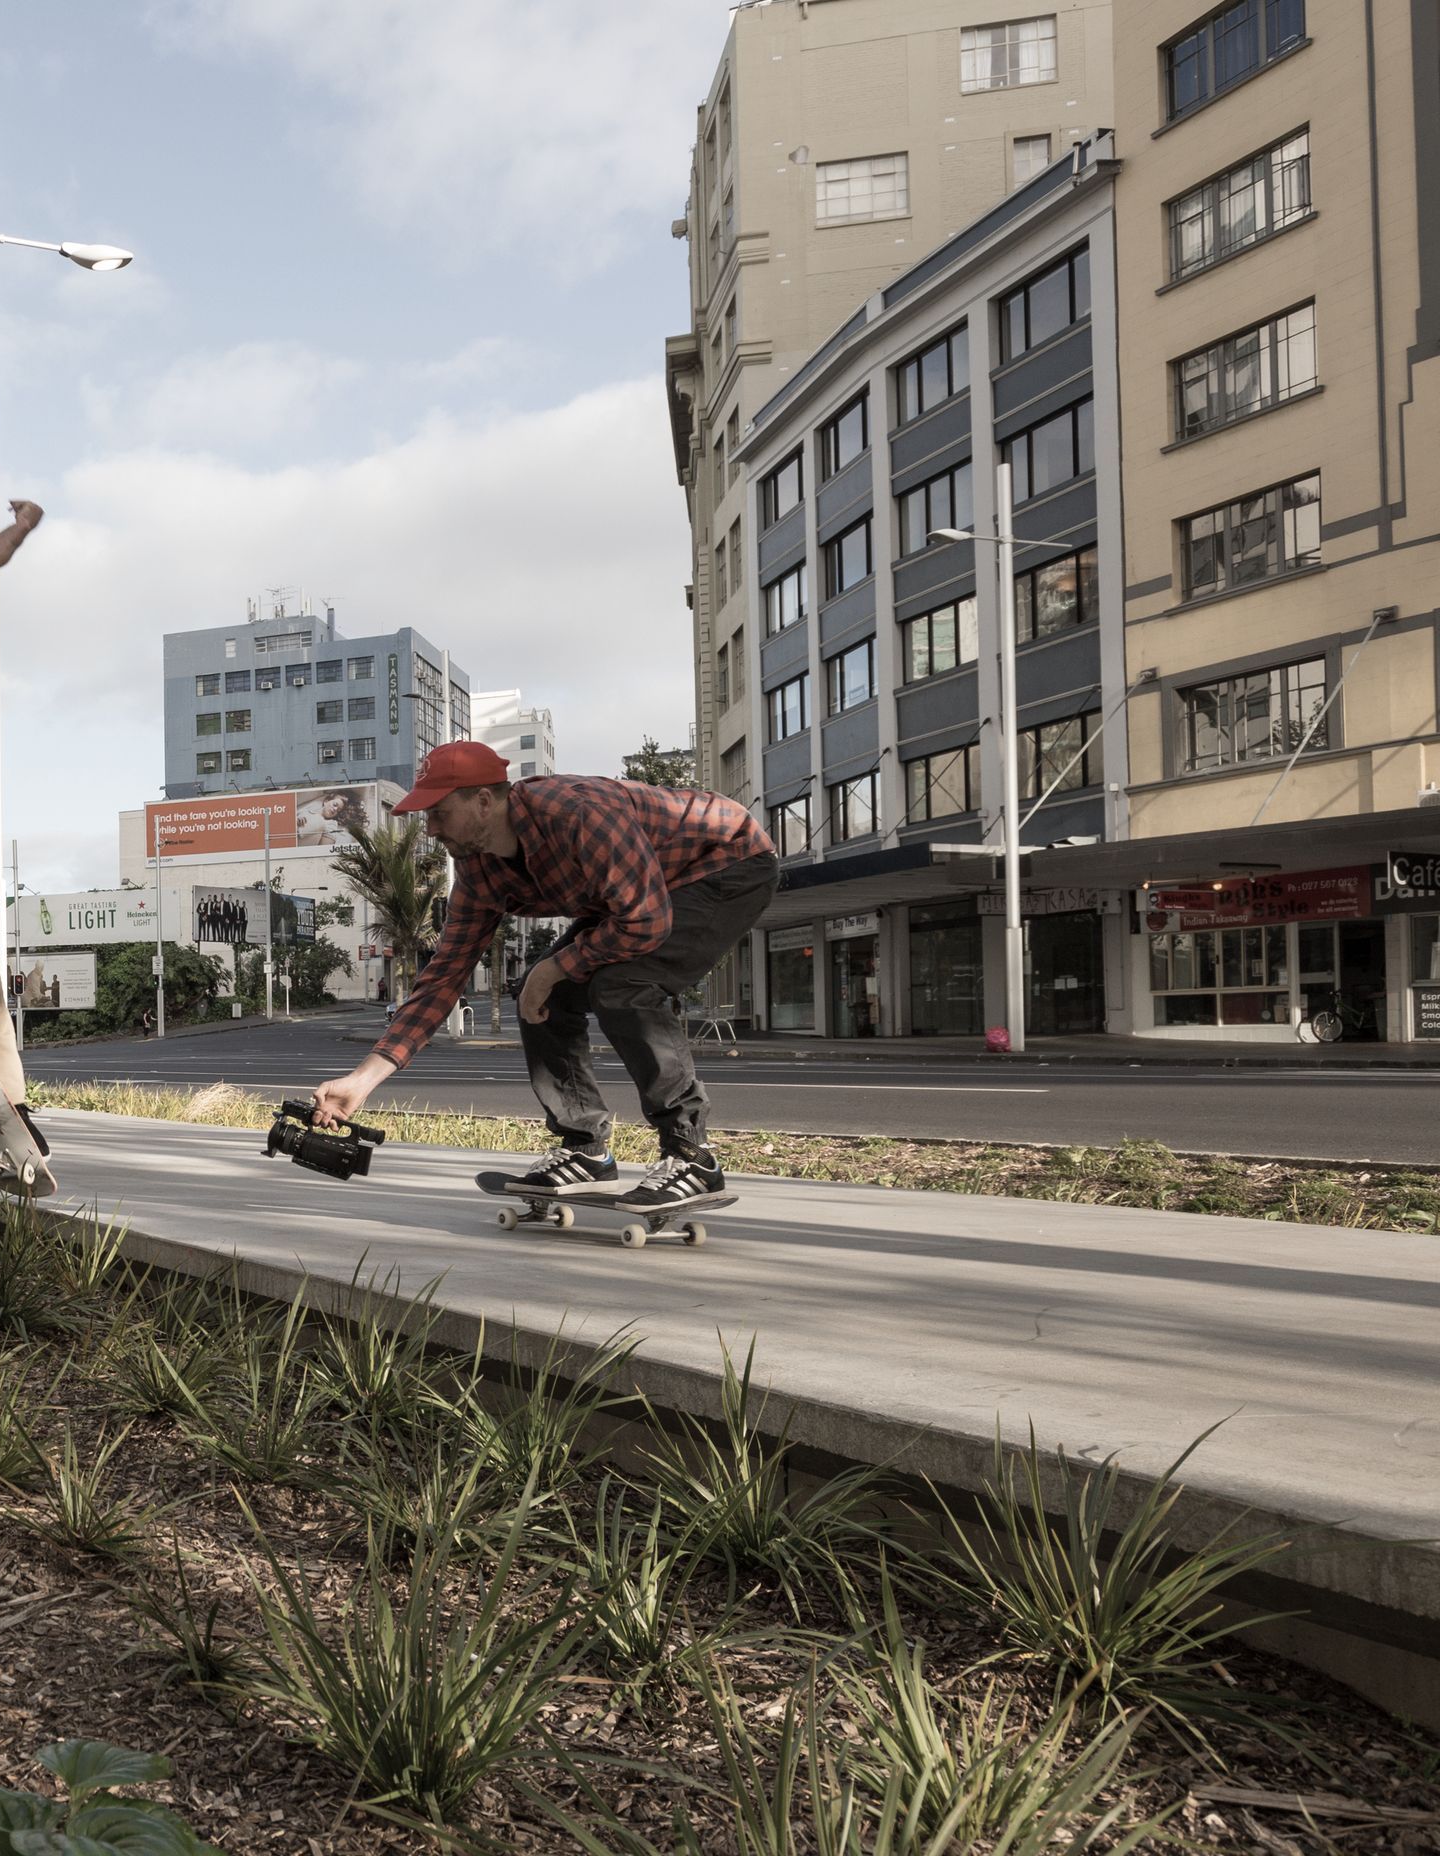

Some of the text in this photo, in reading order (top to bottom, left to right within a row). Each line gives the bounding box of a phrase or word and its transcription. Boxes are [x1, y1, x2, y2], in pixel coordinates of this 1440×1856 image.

[389, 657, 398, 720] TASMAN
[174, 813, 188, 821] the
[189, 812, 207, 820] fare
[209, 808, 236, 821] you're
[238, 806, 271, 817] looking
[274, 804, 286, 813] for
[179, 822, 206, 834] you're
[207, 821, 222, 831] not
[223, 818, 259, 830] looking.
[329, 844, 361, 853] Jetstar
[68, 901, 117, 911] GREAT TASTING
[1252, 900, 1309, 918] Style
[68, 909, 117, 930] LIGHT
[126, 911, 158, 919] Heineken
[1183, 916, 1208, 927] Indian
[133, 919, 151, 927] LIGHT
[832, 919, 844, 931] Buy
[844, 917, 855, 928] The
[855, 916, 868, 927] Way
